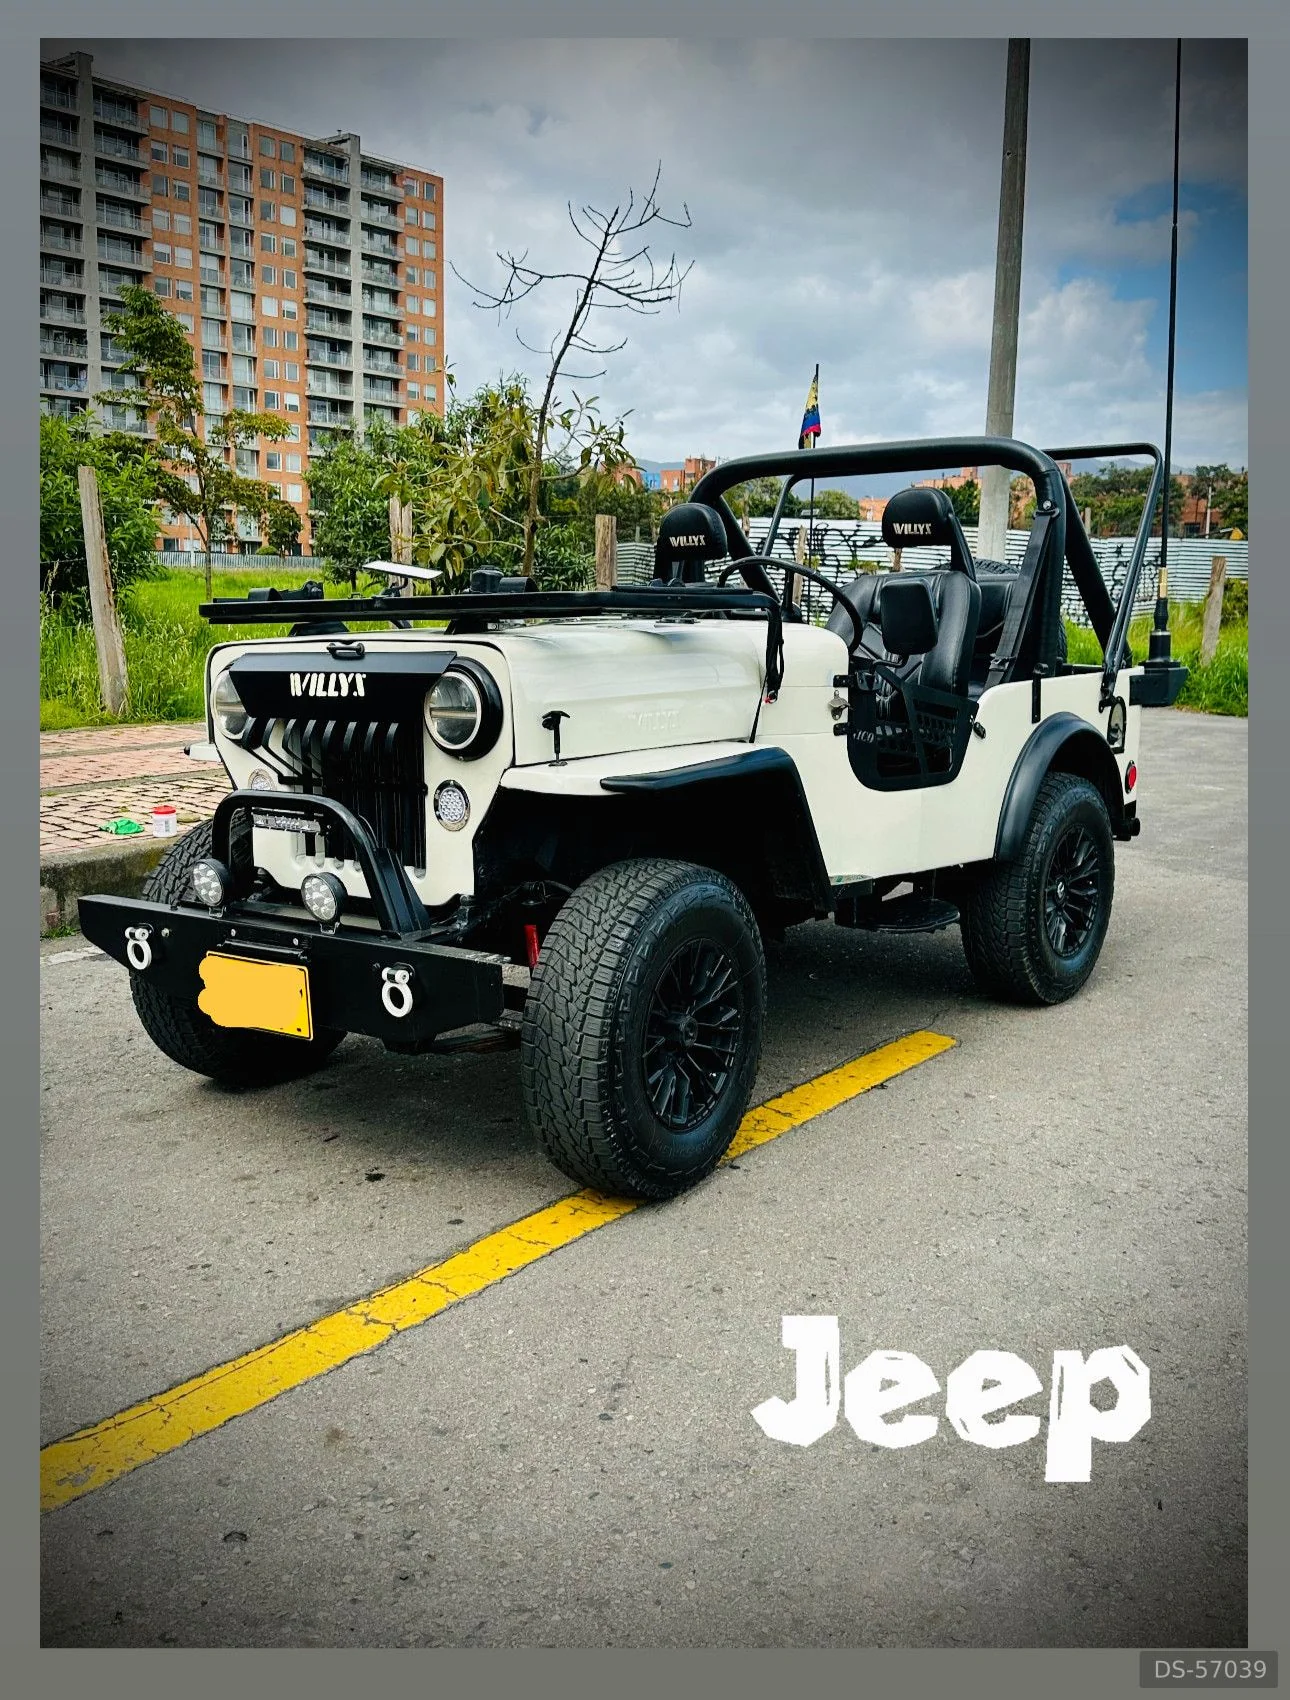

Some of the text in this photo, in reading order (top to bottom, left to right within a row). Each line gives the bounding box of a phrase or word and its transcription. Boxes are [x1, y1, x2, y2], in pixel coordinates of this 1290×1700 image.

[892, 522, 932, 535] WILLYS
[669, 534, 706, 547] WILLYS
[289, 672, 367, 697] WILLYS
